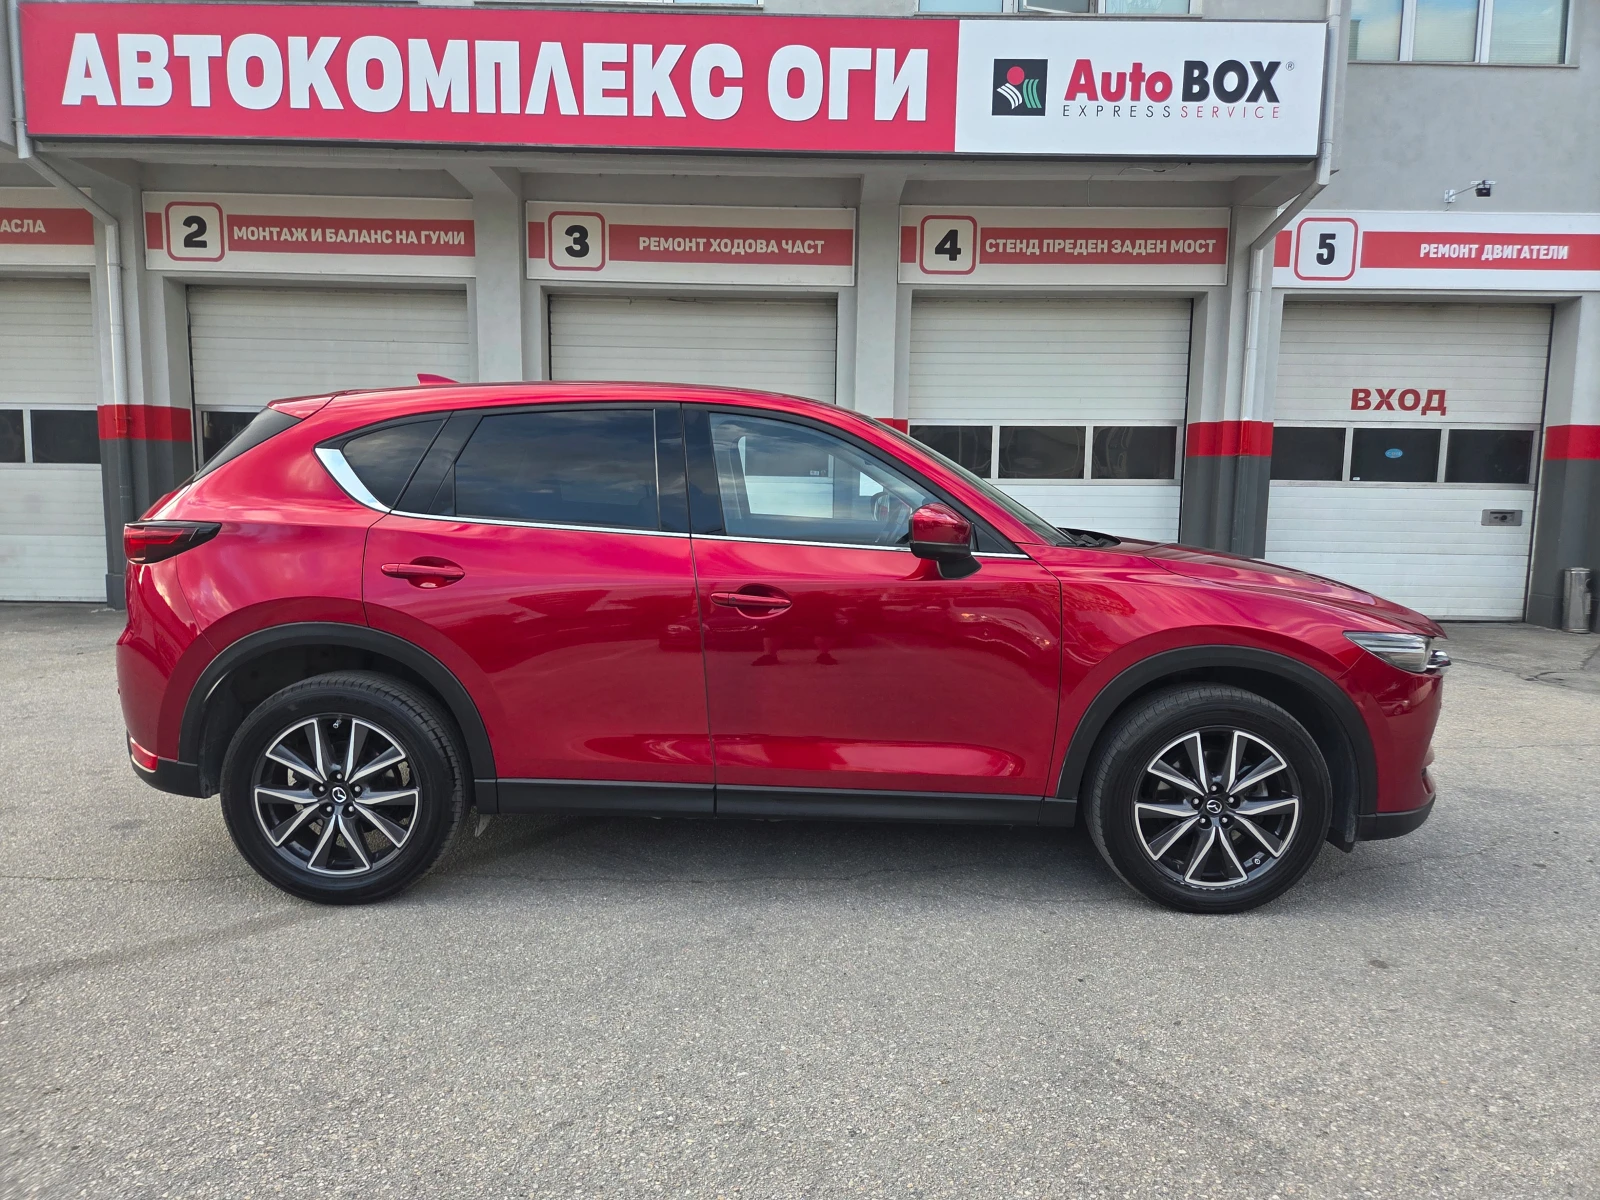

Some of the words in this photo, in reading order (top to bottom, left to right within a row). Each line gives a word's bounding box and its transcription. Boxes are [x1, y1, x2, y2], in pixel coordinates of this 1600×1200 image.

[61, 32, 744, 120] АВТОКОМПЛЕКС
[767, 44, 929, 122] ОГИ
[1063, 58, 1173, 103] Auto
[1181, 59, 1281, 104] BOX
[182, 215, 208, 249] 2
[233, 226, 308, 243] МОНТАЖ
[310, 228, 323, 242] И
[325, 229, 393, 244] БАЛАНС
[395, 230, 419, 245] НА
[420, 230, 465, 245] ГУМИ
[564, 224, 590, 258] 3
[639, 237, 706, 252] РЕМОНТ
[709, 238, 779, 255] ХОДОВА
[781, 239, 825, 254] ЧАСТ
[934, 229, 962, 262] 4
[985, 239, 1040, 256] СТЕНД
[1042, 239, 1108, 256] ПРЕДЕН
[1110, 239, 1168, 256] ЗАДЕН
[1170, 239, 1217, 254] МОСТ
[1316, 233, 1337, 266] 5
[1419, 243, 1479, 259] РЕМОНТ
[1481, 244, 1569, 261] ДВИГАТЕЛИ
[1350, 387, 1447, 417] ВХОД
